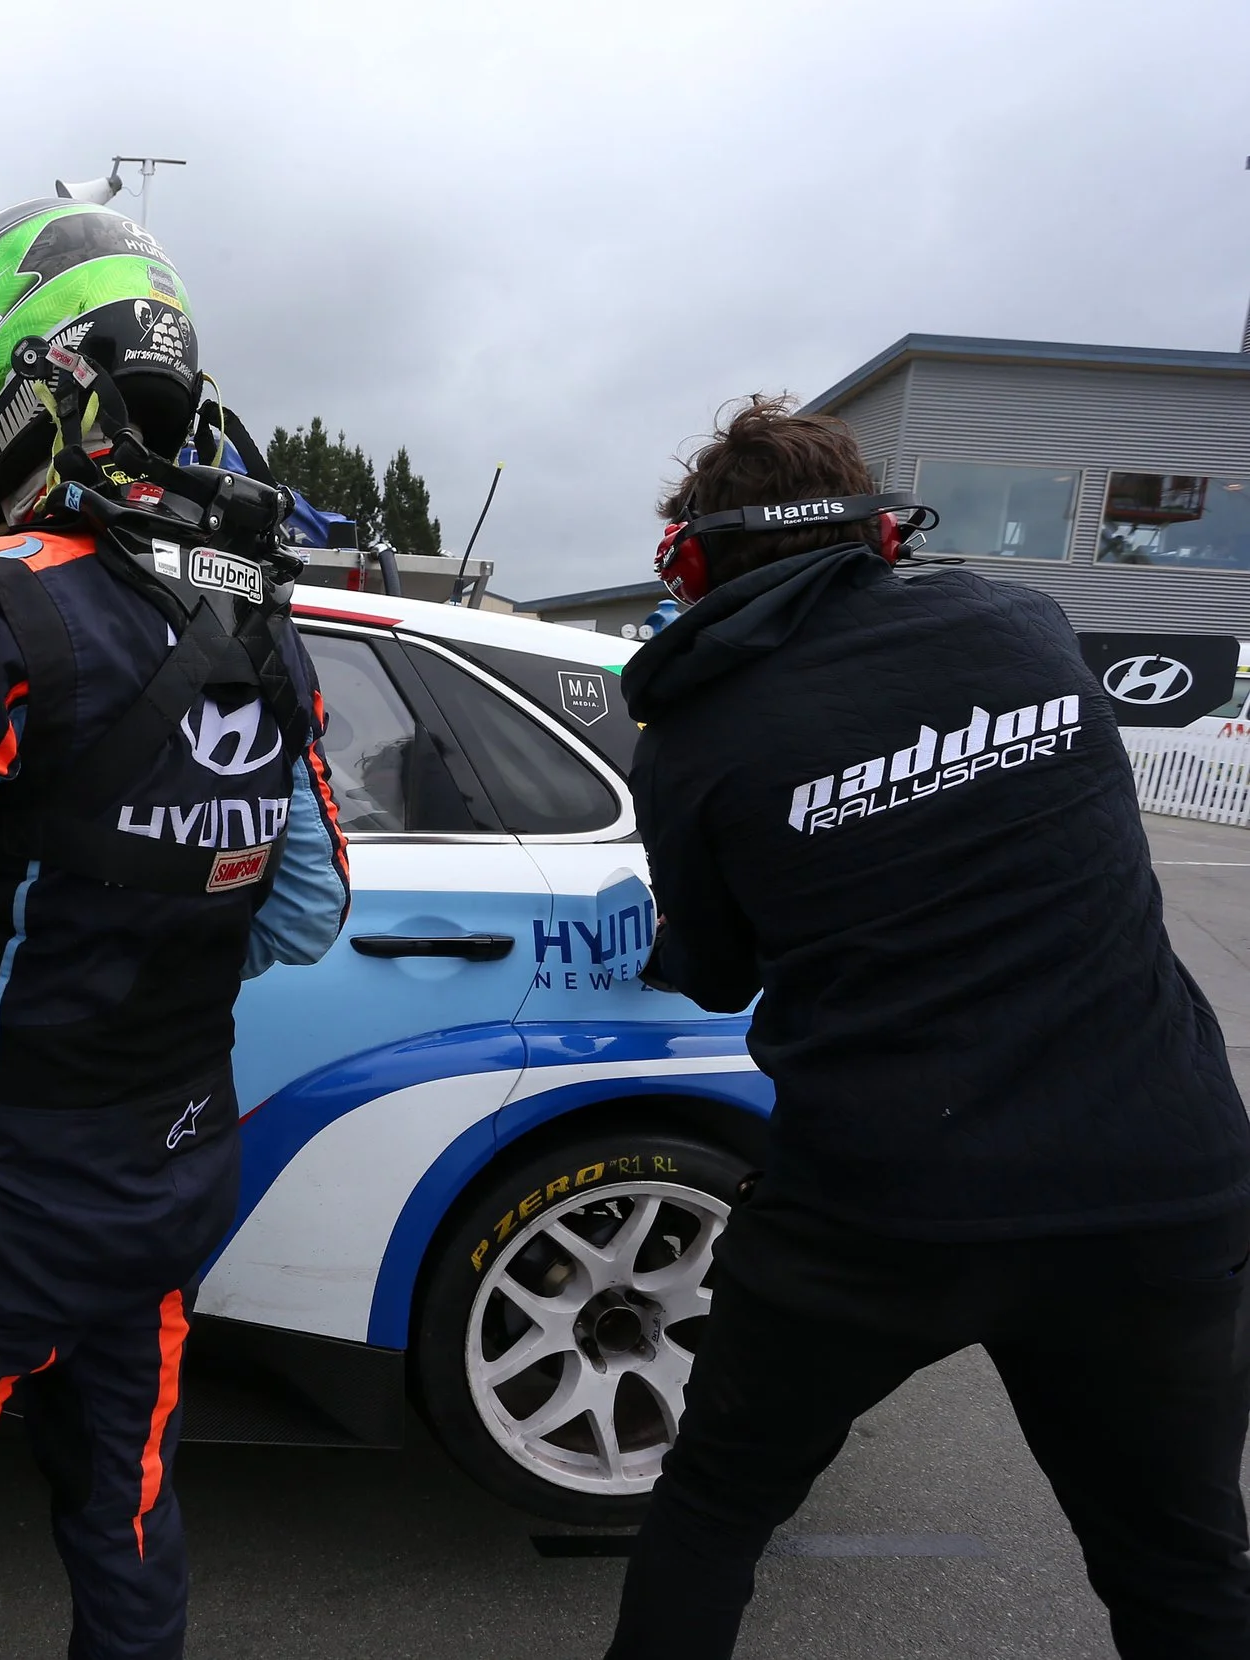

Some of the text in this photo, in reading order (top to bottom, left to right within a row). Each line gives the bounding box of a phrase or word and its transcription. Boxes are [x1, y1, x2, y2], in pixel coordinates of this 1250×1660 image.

[763, 499, 846, 522] Harris
[783, 515, 829, 526] Race Radios
[198, 556, 257, 591] Hybrid
[250, 591, 261, 600] PRO
[568, 679, 599, 699] MA
[788, 694, 1080, 832] paddon
[808, 726, 1082, 836] RALLYSPORT
[215, 855, 262, 882] SIMPSON
[535, 971, 612, 991] NEW
[652, 1155, 678, 1173] RL
[470, 1162, 606, 1272] P ZERO
